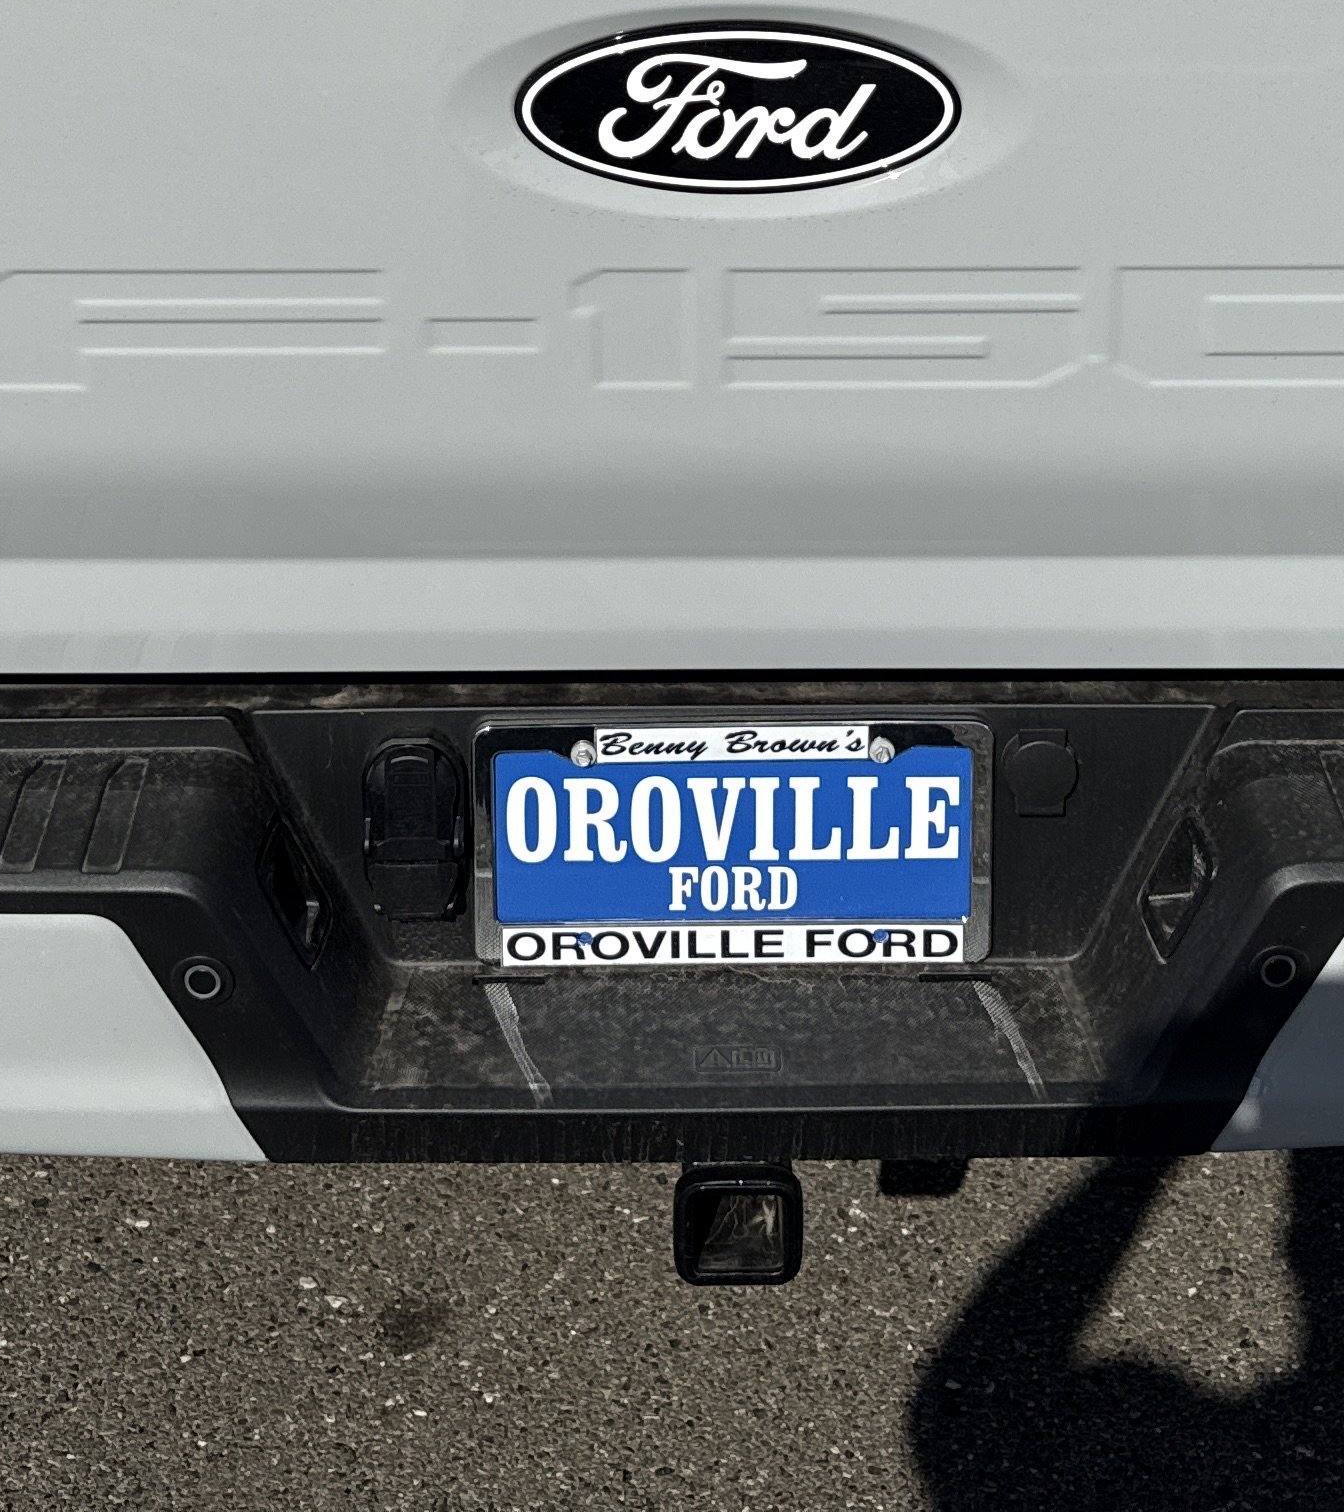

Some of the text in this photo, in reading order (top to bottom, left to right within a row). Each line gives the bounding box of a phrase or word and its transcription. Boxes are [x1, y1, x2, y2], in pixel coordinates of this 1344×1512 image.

[596, 52, 876, 162] Ford
[599, 729, 867, 760] Benny Brown's
[505, 775, 961, 864] OROVILLE
[668, 865, 798, 913] FORD
[506, 928, 959, 961] OROVILLE FORD
